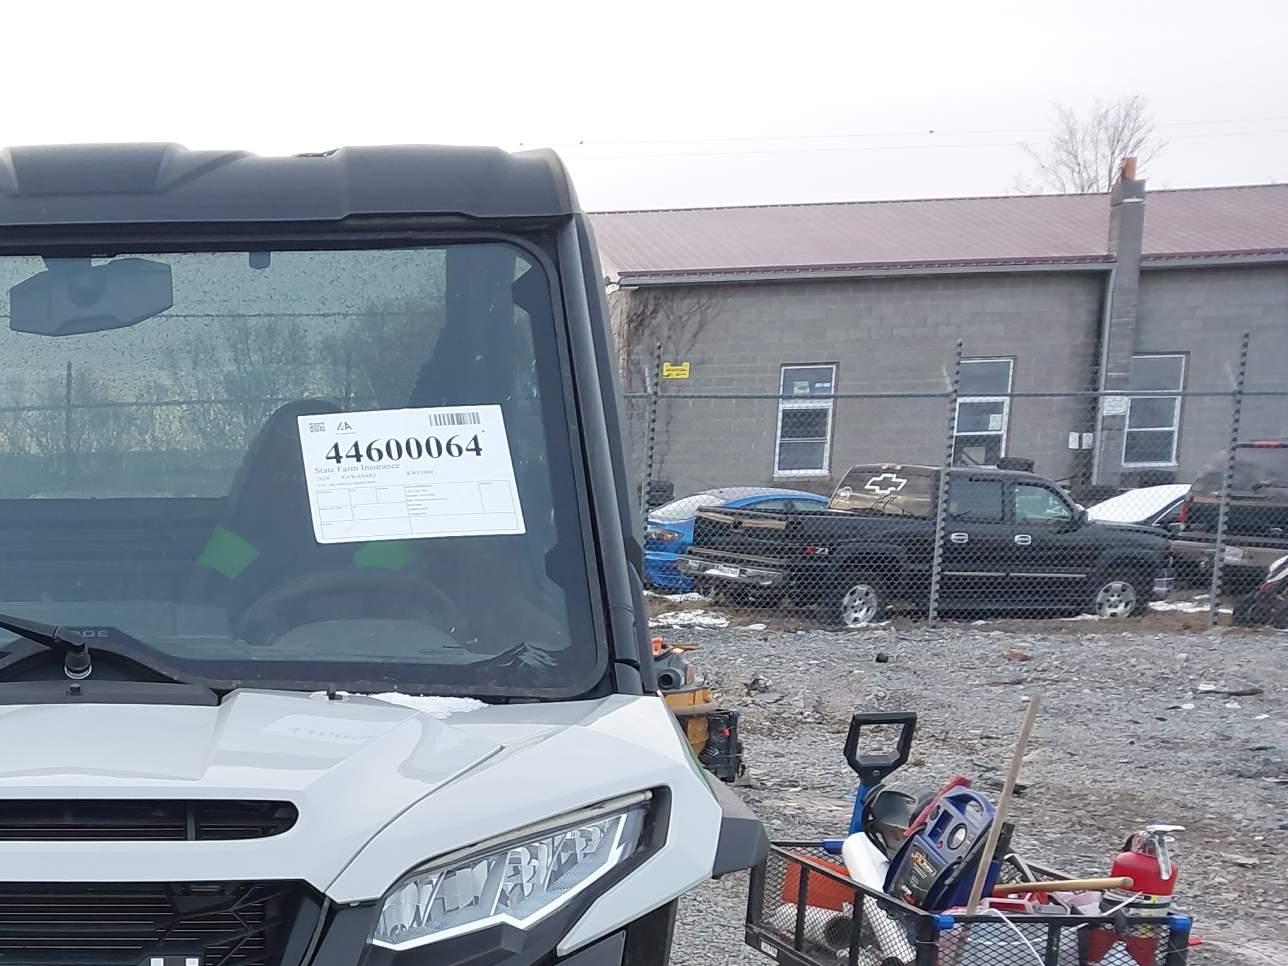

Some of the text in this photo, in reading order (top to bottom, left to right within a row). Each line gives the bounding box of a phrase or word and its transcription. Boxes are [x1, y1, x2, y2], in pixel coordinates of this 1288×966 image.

[325, 434, 483, 464] 44600064
[314, 463, 401, 474] State Farm Insurance
